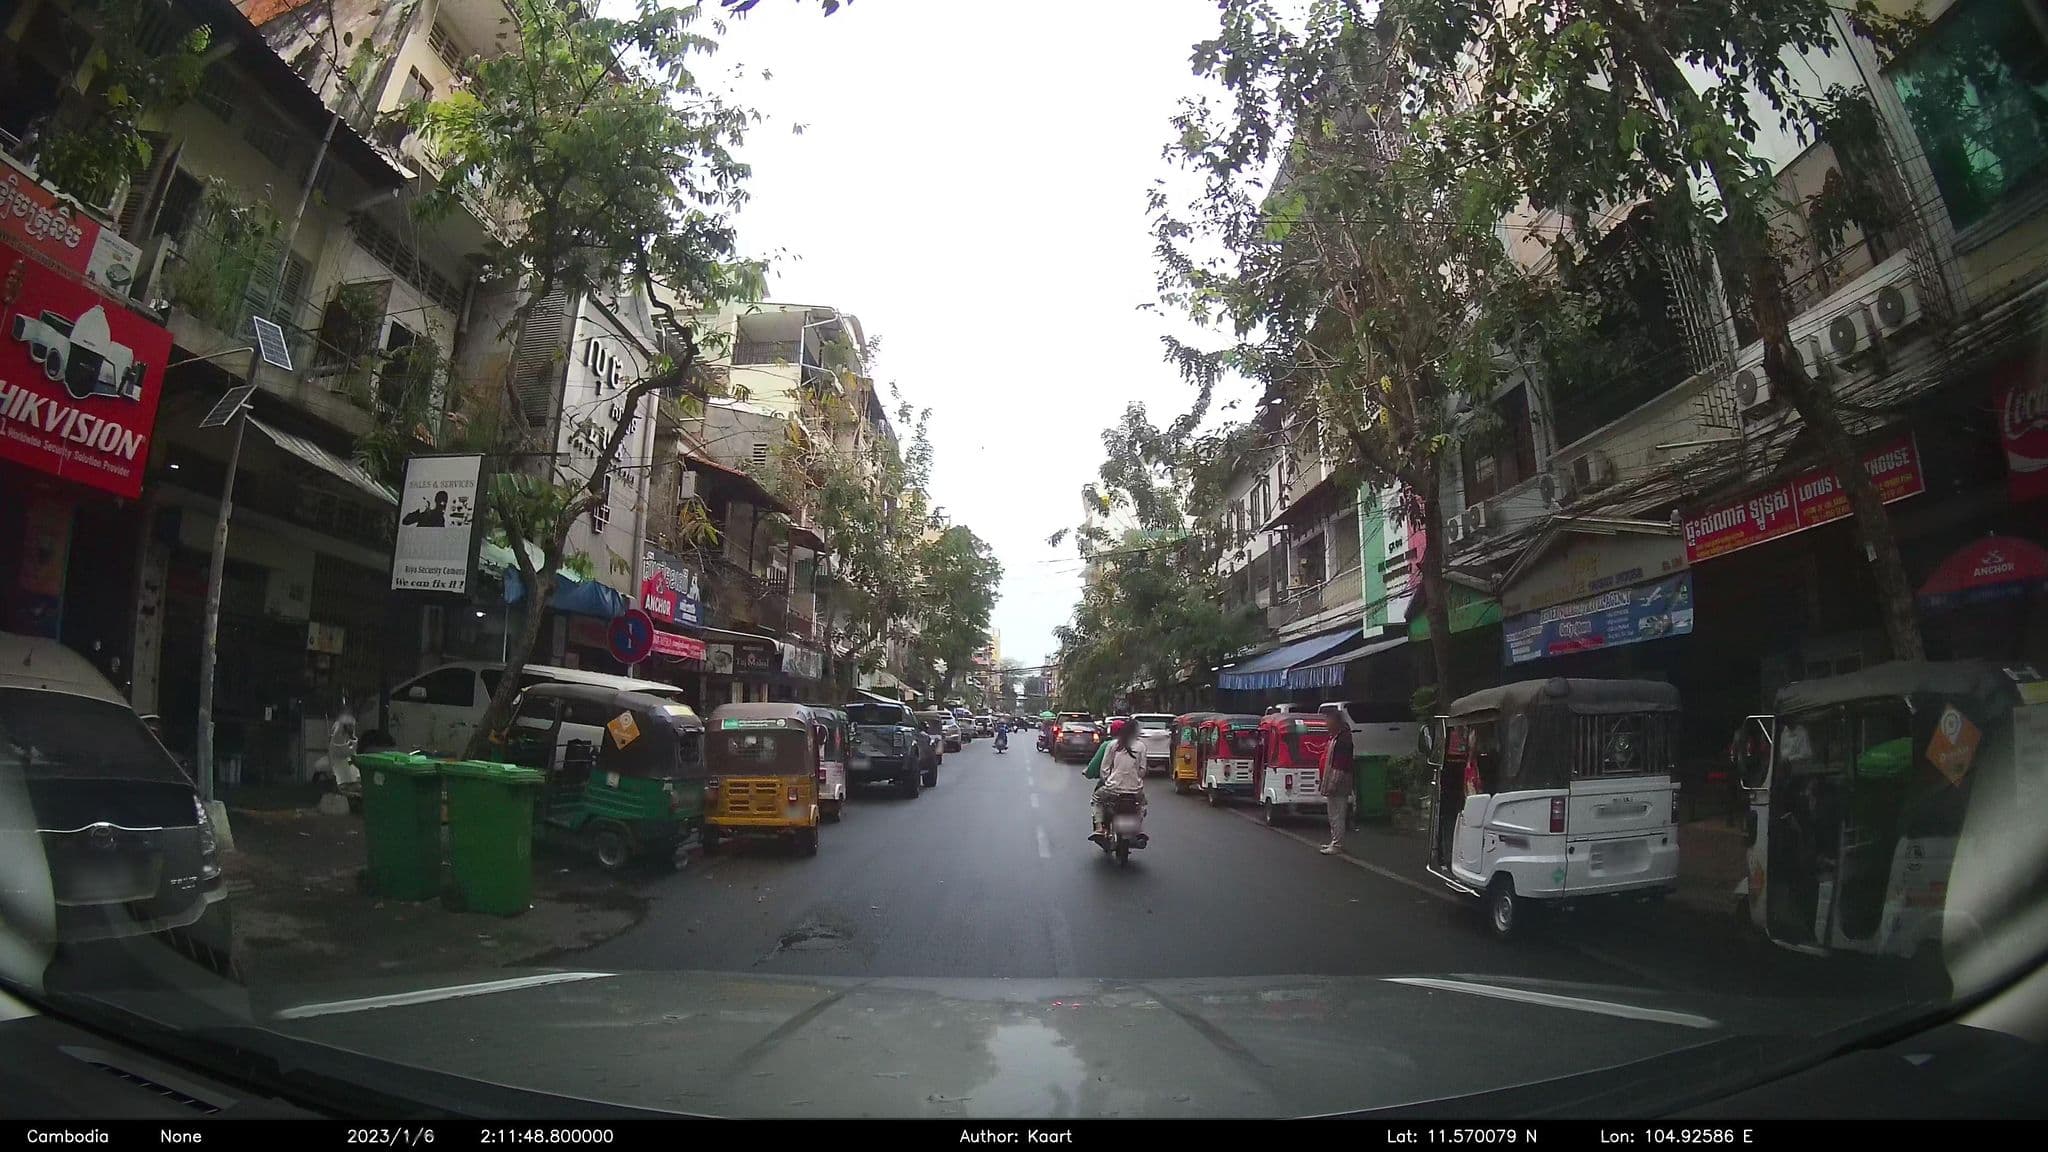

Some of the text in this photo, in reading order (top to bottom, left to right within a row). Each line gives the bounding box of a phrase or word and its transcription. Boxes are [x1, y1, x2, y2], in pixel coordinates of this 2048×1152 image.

[0, 383, 143, 460] HIKVISION
[43, 439, 73, 460] Security
[74, 450, 102, 468] Solution
[103, 460, 131, 478] Provider
[408, 480, 432, 488] SALES
[440, 479, 475, 488] SERVICES
[1798, 476, 1833, 502] LOTUS
[1973, 562, 2015, 577] ANCHOR
[395, 577, 409, 587] We
[410, 580, 430, 588] can
[432, 579, 447, 588] fix
[645, 594, 672, 616] ANCHOR
